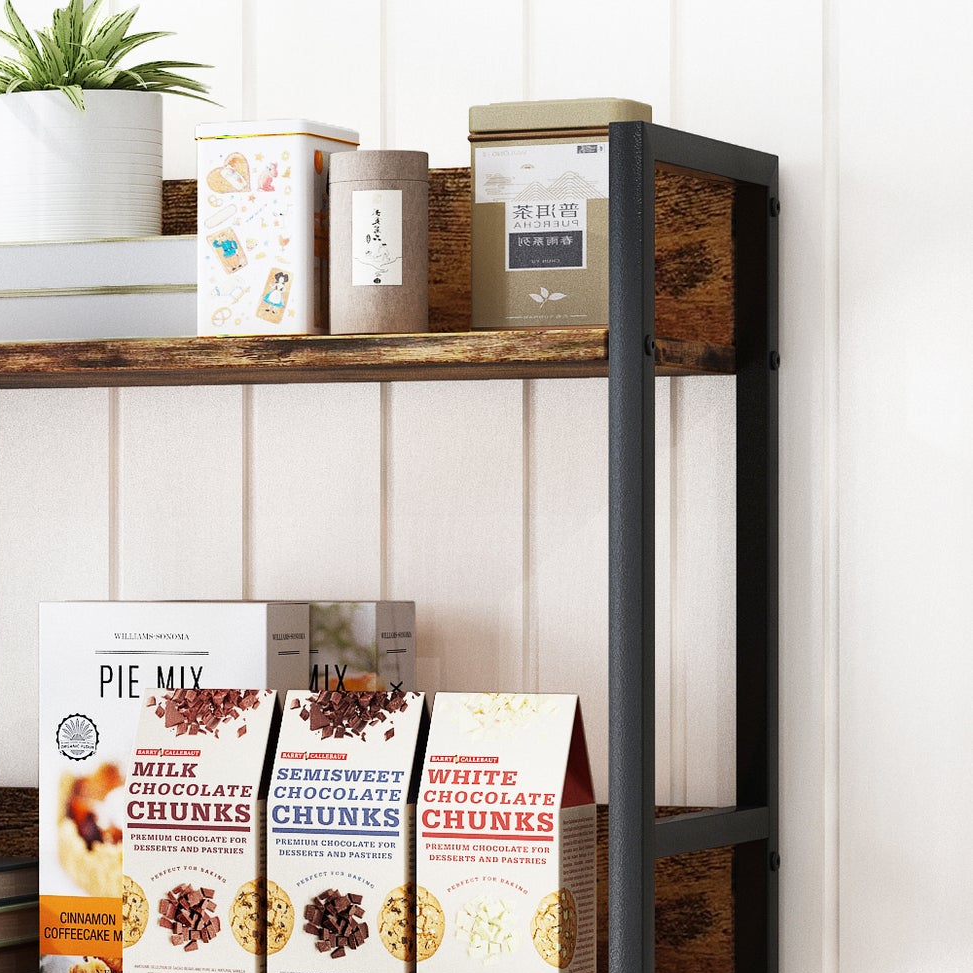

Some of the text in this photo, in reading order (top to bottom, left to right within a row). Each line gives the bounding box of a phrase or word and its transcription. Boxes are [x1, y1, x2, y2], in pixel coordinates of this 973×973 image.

[100, 665, 203, 698] PIE MIX
[132, 762, 198, 777] MILK
[277, 768, 404, 783] SEMISWEET
[428, 769, 518, 786] WHITE
[129, 782, 253, 797] CHOCOLATE
[274, 786, 402, 801] CHOCOLATE
[423, 790, 555, 806] CHOCOLATE
[127, 801, 251, 823] CHUNKS
[272, 805, 400, 827] CHUNKS
[422, 809, 554, 832] CHUNKS
[130, 833, 172, 841] PREMIUM
[174, 835, 227, 843] CHOCOLATE
[275, 838, 318, 846] PREMIUM
[321, 840, 375, 848] CHOCOLATE
[133, 844, 178, 852] DESSERTS
[279, 849, 324, 857] DESSERTS
[426, 843, 550, 854] PREMIUM CHOCOLATE FOR
[429, 854, 476, 863] DESSERTS
[502, 857, 547, 865] PASTRIES
[60, 911, 116, 926] CINNAMON
[44, 926, 123, 942] COFFEECAKE M
